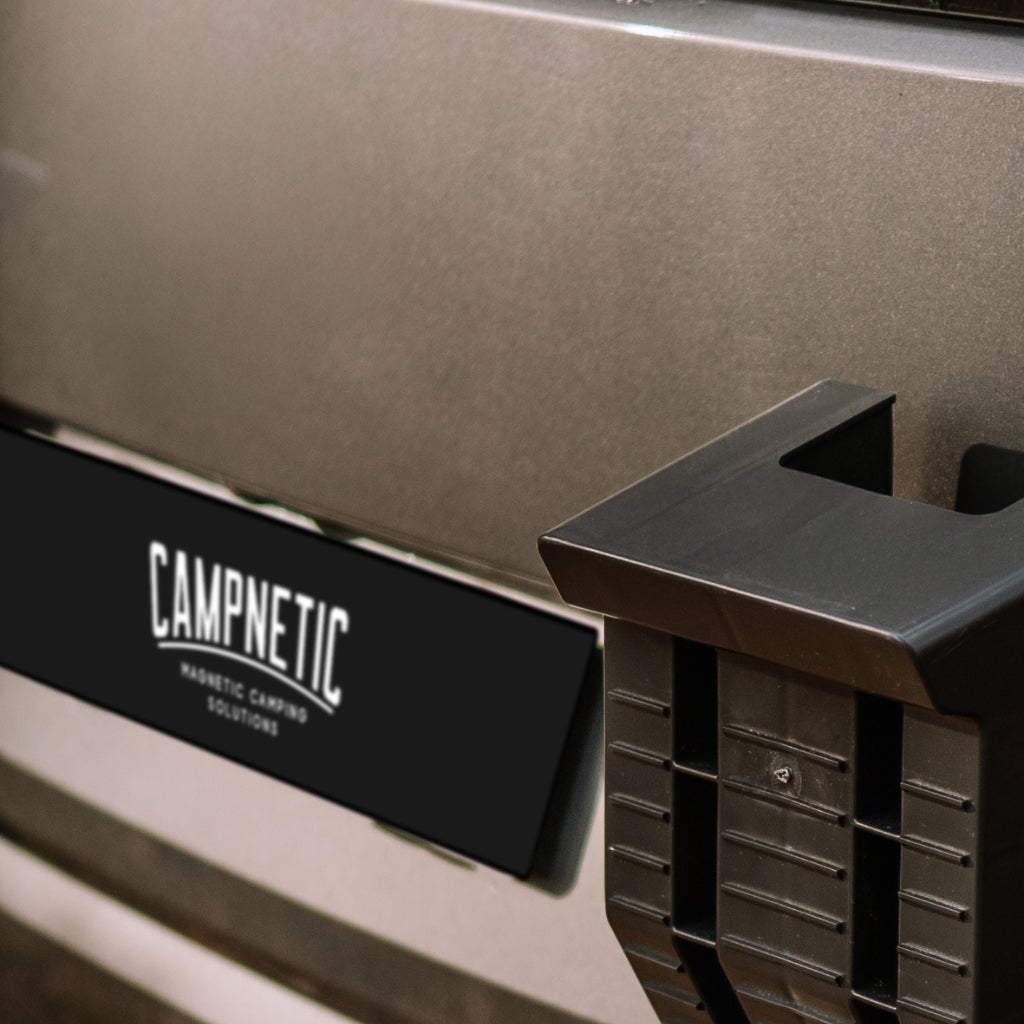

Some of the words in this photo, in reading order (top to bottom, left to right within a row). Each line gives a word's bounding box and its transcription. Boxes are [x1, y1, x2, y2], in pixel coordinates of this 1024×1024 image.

[149, 541, 348, 707] CAMPNETIC
[180, 661, 244, 699] MAGNETIC
[249, 688, 308, 724] CAMPING
[207, 696, 278, 736] SOLUTIONS
